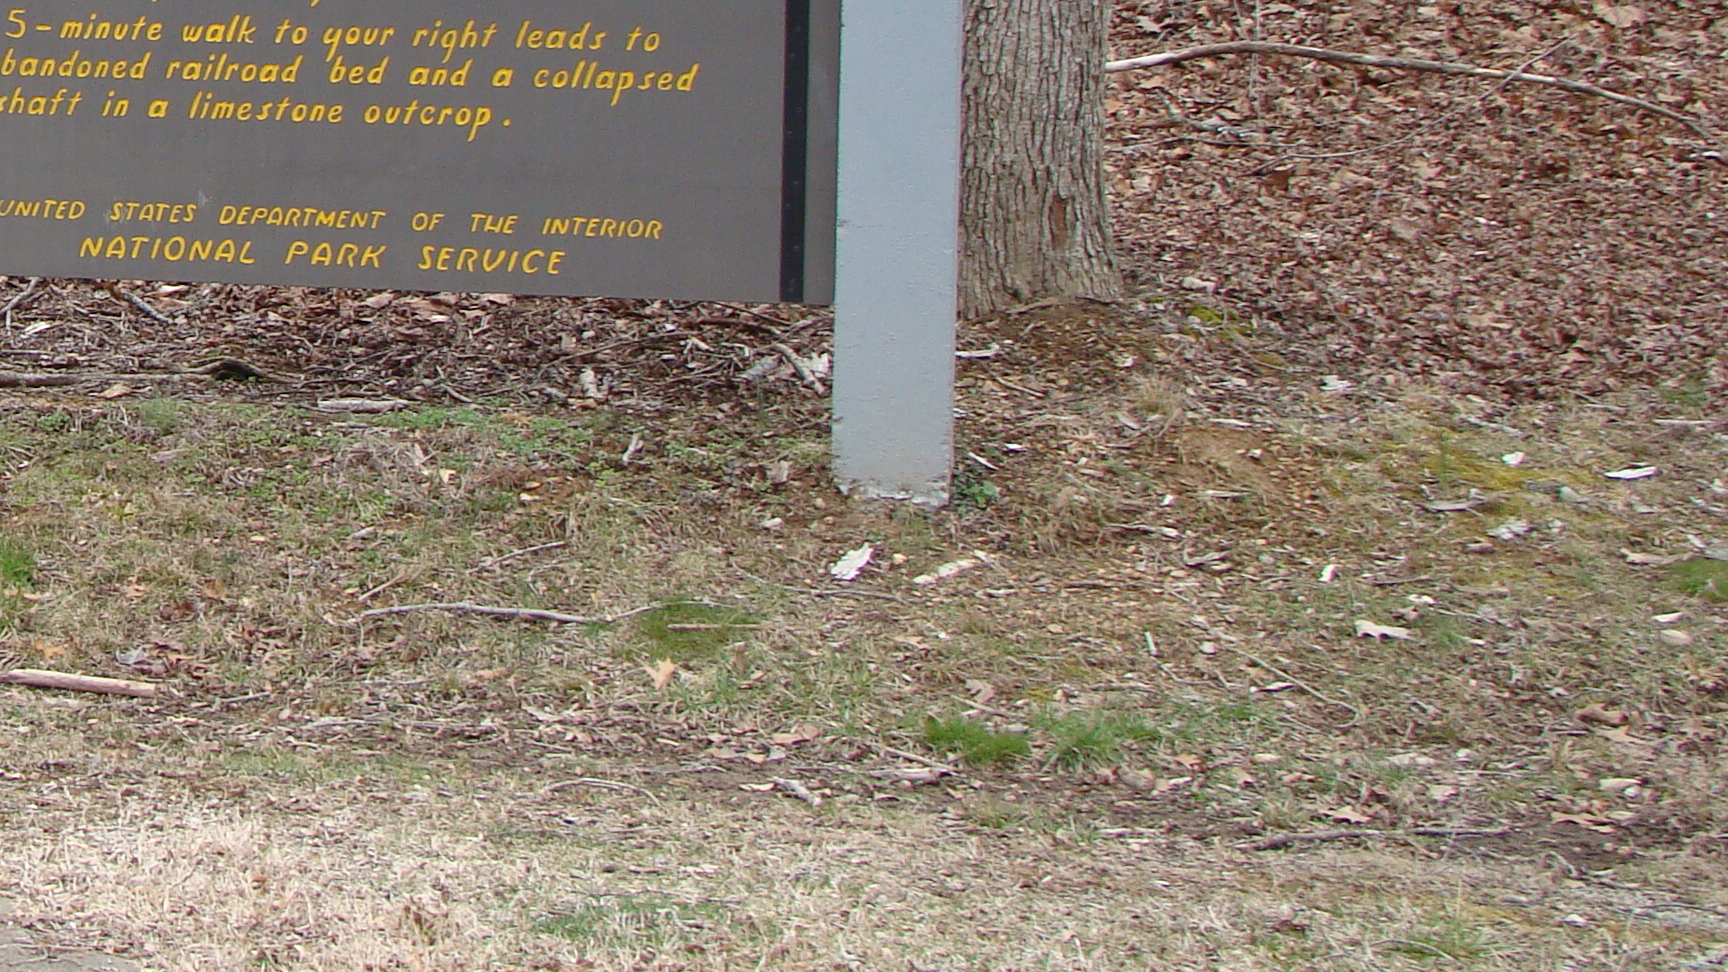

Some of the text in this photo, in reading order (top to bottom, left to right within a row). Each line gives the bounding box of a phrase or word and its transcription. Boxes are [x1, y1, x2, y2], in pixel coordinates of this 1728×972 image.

[180, 13, 257, 44] walk
[273, 17, 309, 46] to
[321, 24, 396, 63] your
[410, 18, 497, 64] right
[513, 18, 607, 51] leads
[624, 25, 661, 53] to
[164, 51, 305, 84] railroad
[327, 54, 390, 85] bed
[407, 58, 474, 87] and
[490, 66, 515, 88] a
[532, 58, 700, 107] collapsed
[100, 88, 131, 117] in
[146, 98, 171, 119] a
[187, 90, 345, 125] limestone
[108, 200, 198, 225] STATES
[217, 203, 386, 230] DEPARTMENT
[410, 210, 445, 232] OF
[470, 212, 519, 235] THE
[540, 215, 664, 239] INTERIOR
[78, 234, 566, 276] NATIONAL PARK SERVICE
